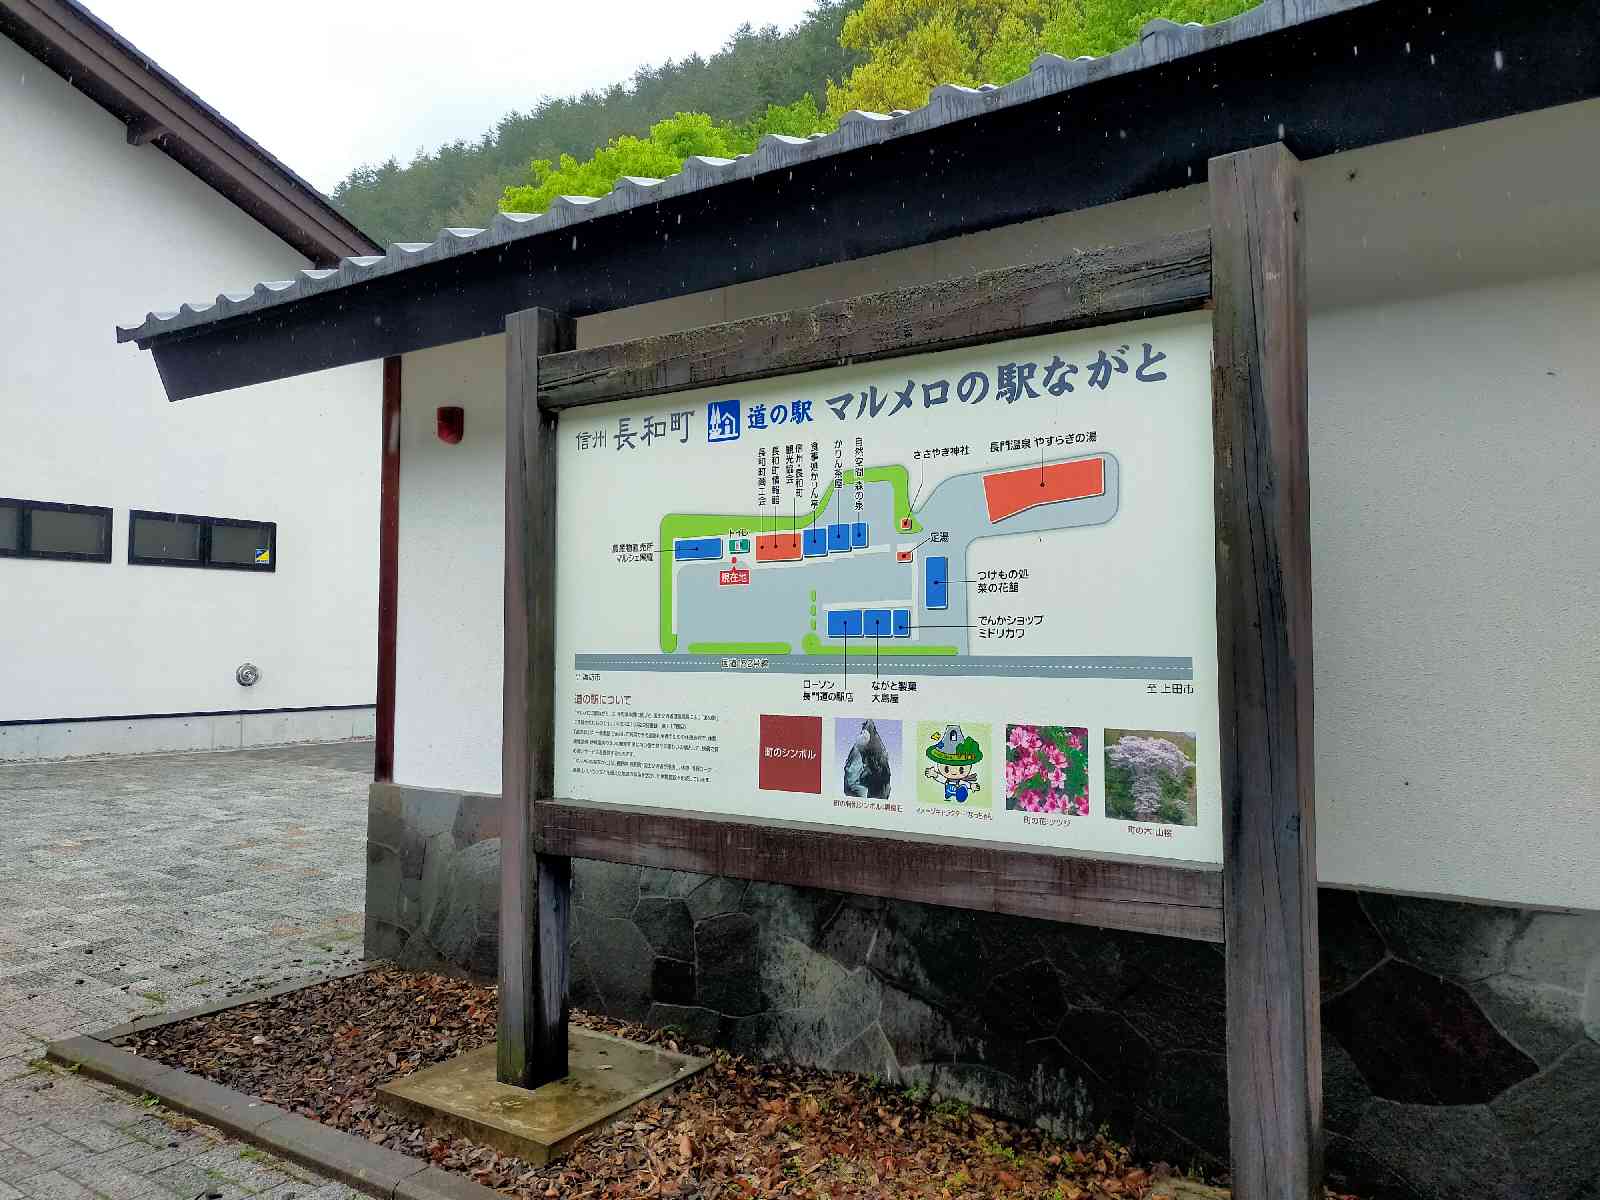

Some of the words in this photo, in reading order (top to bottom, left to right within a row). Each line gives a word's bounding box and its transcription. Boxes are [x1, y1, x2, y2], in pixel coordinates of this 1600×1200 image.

[825, 342, 1168, 421] マルメロの駅ながと
[747, 399, 814, 431] 道の駅
[575, 429, 607, 451] 信州
[613, 410, 695, 451] 長和町
[990, 438, 1032, 453] 長門温泉
[1034, 431, 1097, 448] やすらぎの湯
[913, 445, 971, 460] ささやき神社
[785, 444, 794, 484] 観光協会
[930, 531, 949, 543] 足湯
[721, 572, 747, 583] 現在地
[977, 569, 1029, 580] つけもの処
[977, 582, 1019, 593] 菜の花館
[978, 615, 1043, 626] でんかショップ
[979, 628, 1025, 639] ミドリカワ
[803, 680, 835, 690] ローソン
[871, 681, 917, 692] ながと製菓
[1160, 683, 1194, 695] 上田市
[802, 691, 854, 702] 長門道の駅店
[871, 693, 899, 704] 大島屋
[764, 746, 817, 760] 町のシンボル
